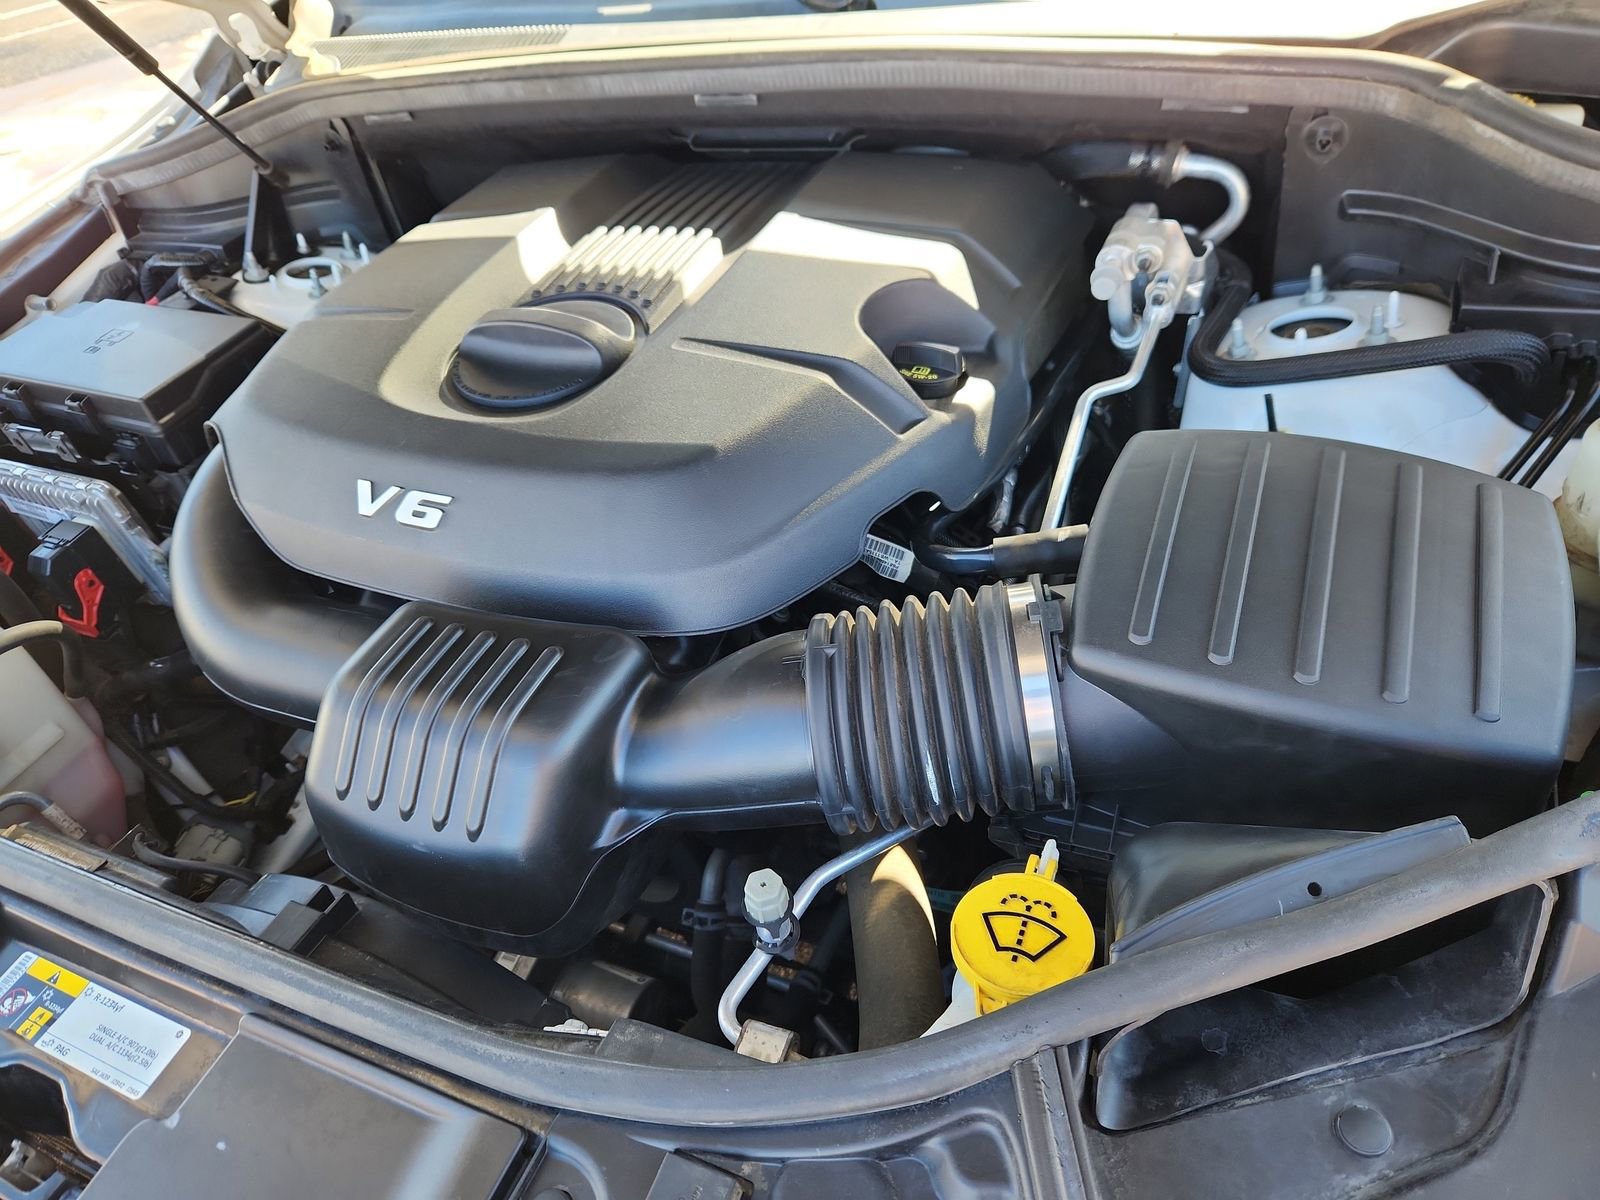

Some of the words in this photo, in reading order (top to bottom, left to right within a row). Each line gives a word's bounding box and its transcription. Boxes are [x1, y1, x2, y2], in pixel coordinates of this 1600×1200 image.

[356, 478, 456, 531] V6
[92, 992, 126, 1013] R-1234yf
[88, 1032, 105, 1045] DUAL
[105, 1041, 119, 1051] A/C
[96, 1024, 118, 1039] SINGLE
[116, 1033, 129, 1044] A/C
[54, 1043, 71, 1057] PAG
